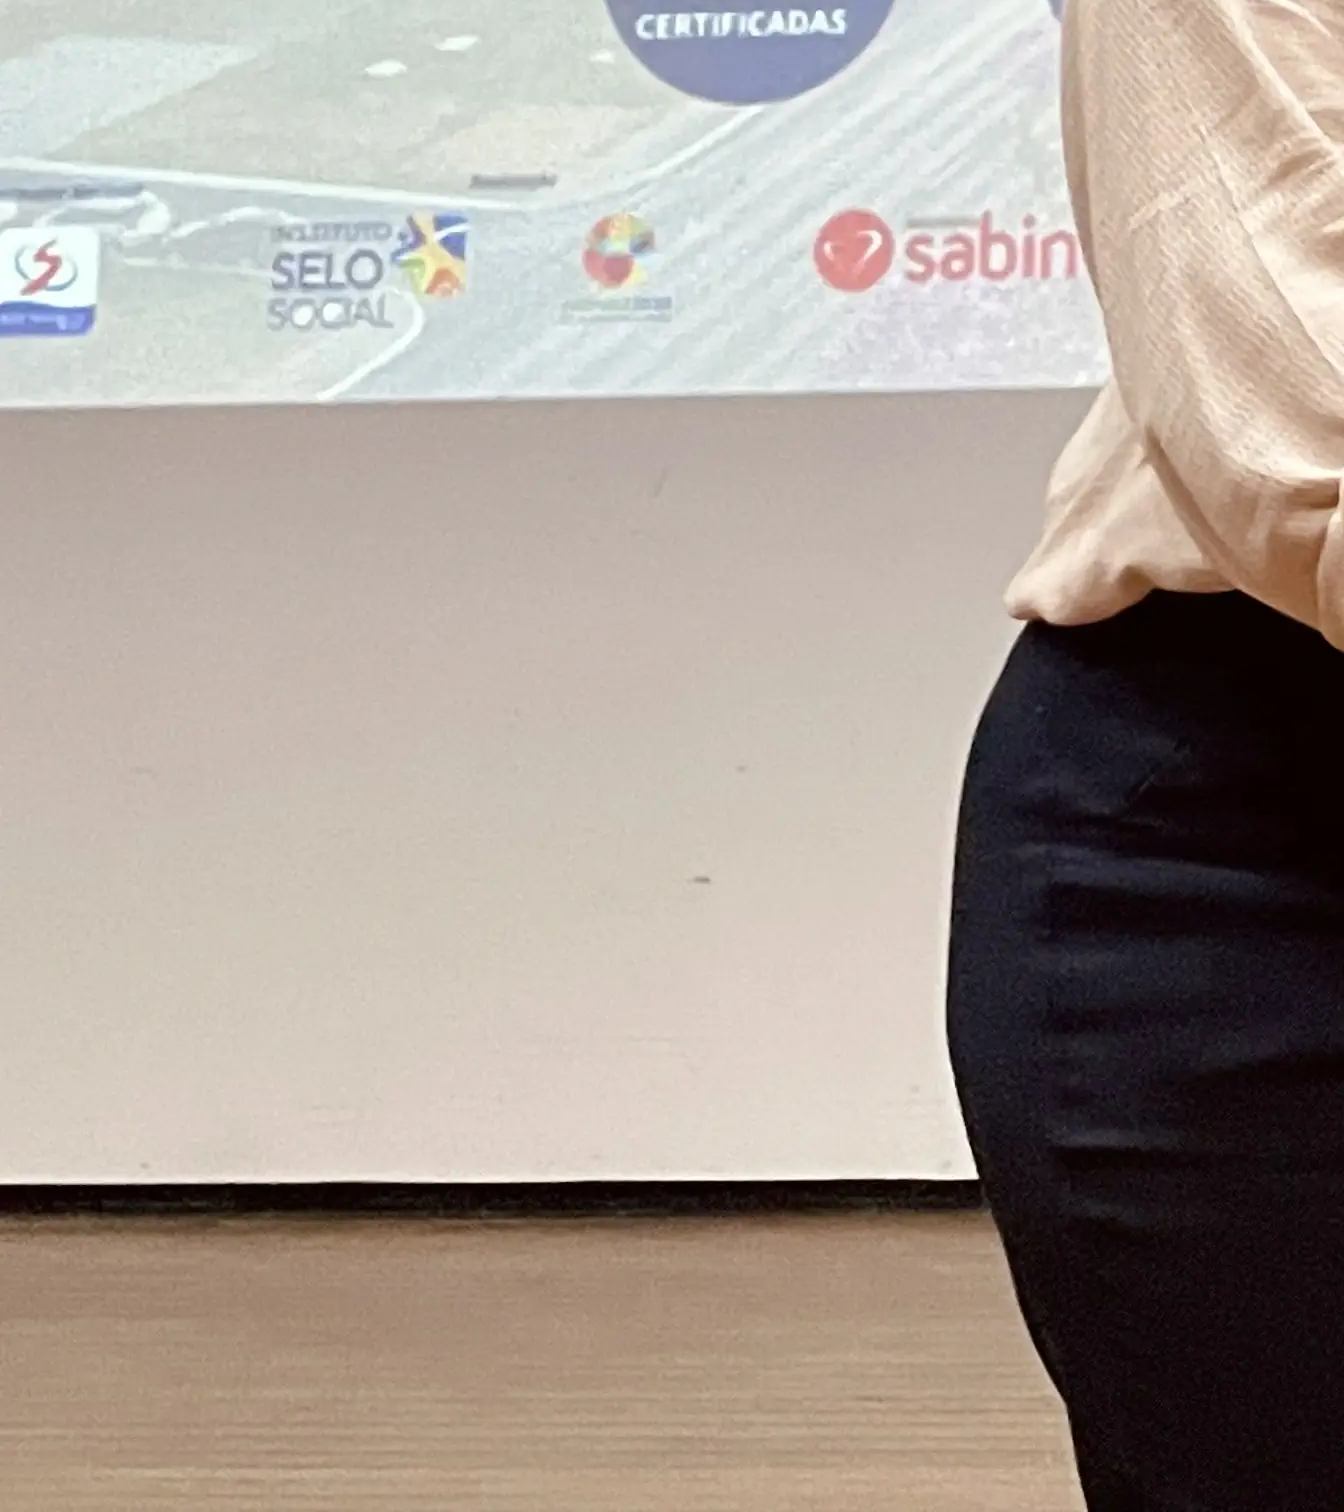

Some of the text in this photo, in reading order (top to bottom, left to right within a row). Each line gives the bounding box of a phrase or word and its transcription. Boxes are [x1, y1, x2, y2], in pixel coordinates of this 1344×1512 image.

[634, 9, 848, 40] CERTIFICADAS
[905, 208, 1078, 283] sabin
[271, 249, 384, 290] SELO
[266, 295, 395, 330] SOCIAL
